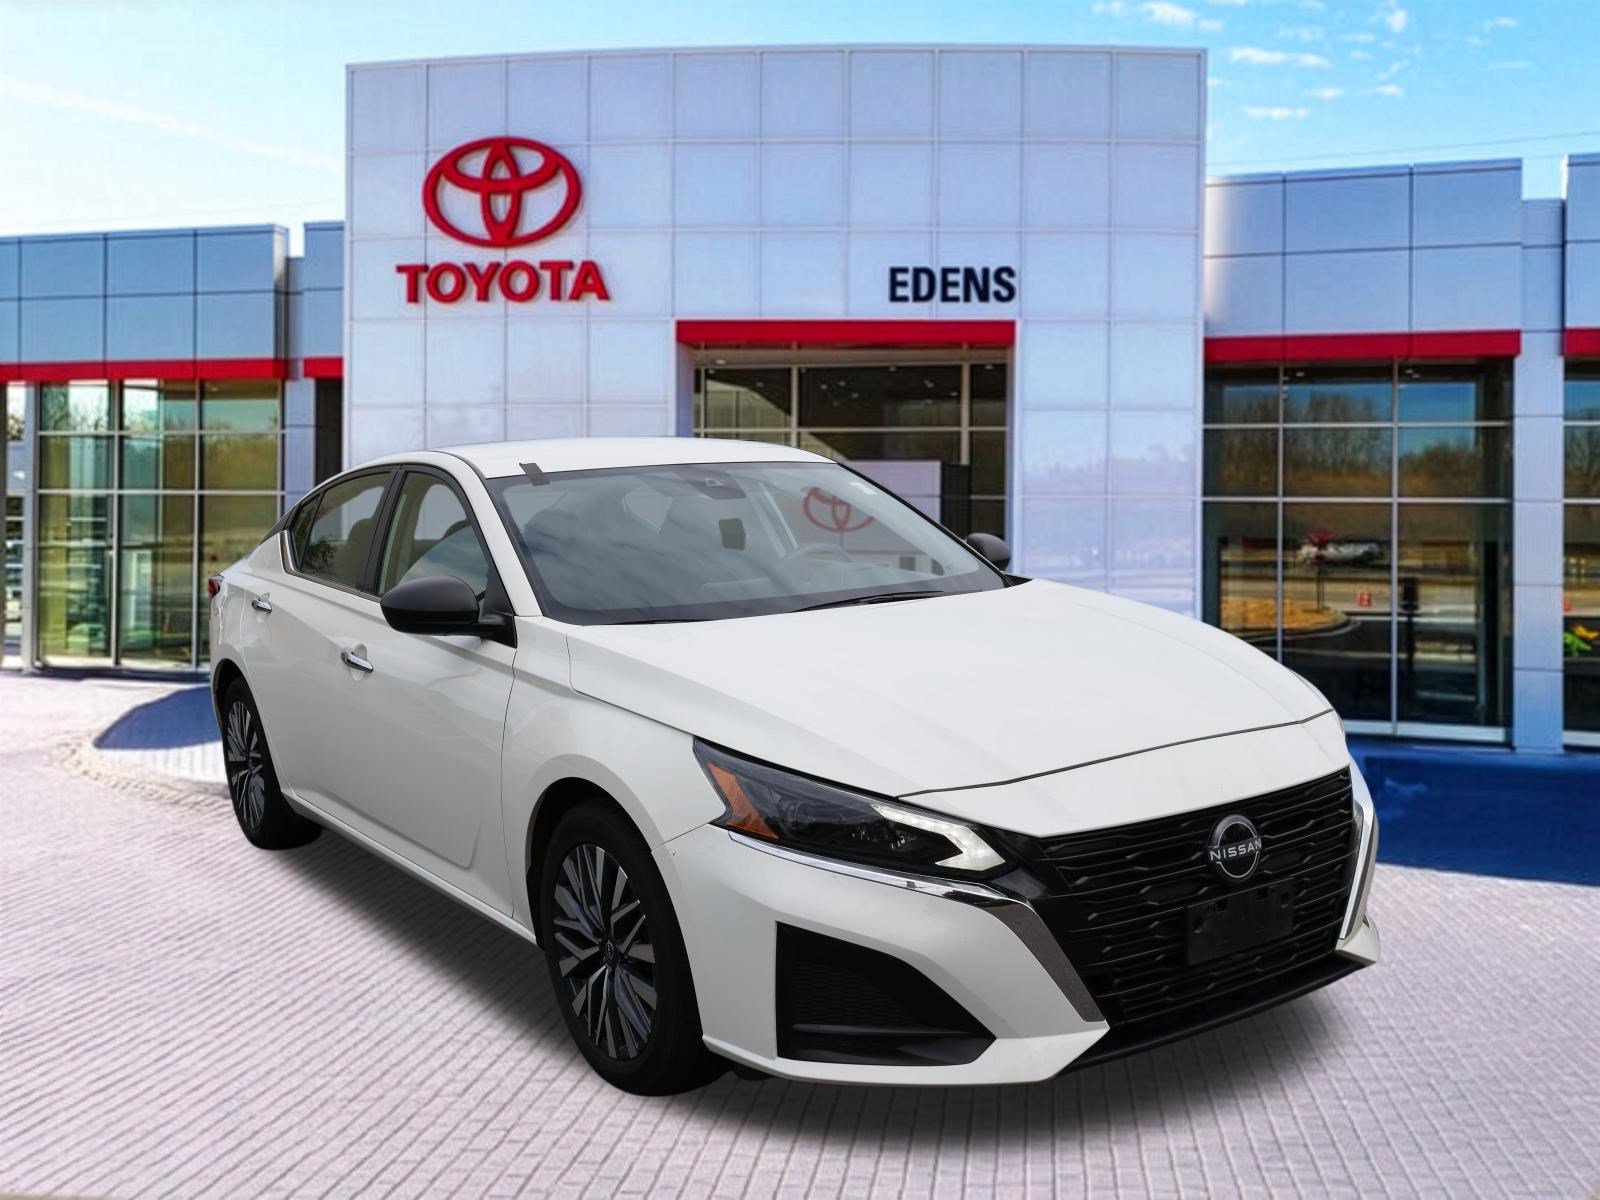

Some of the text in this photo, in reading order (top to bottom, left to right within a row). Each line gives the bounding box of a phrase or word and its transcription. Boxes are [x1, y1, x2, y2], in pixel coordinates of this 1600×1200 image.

[396, 260, 611, 303] TOYOTA
[888, 266, 1017, 303] EDENS
[1209, 838, 1262, 860] NISSAN
